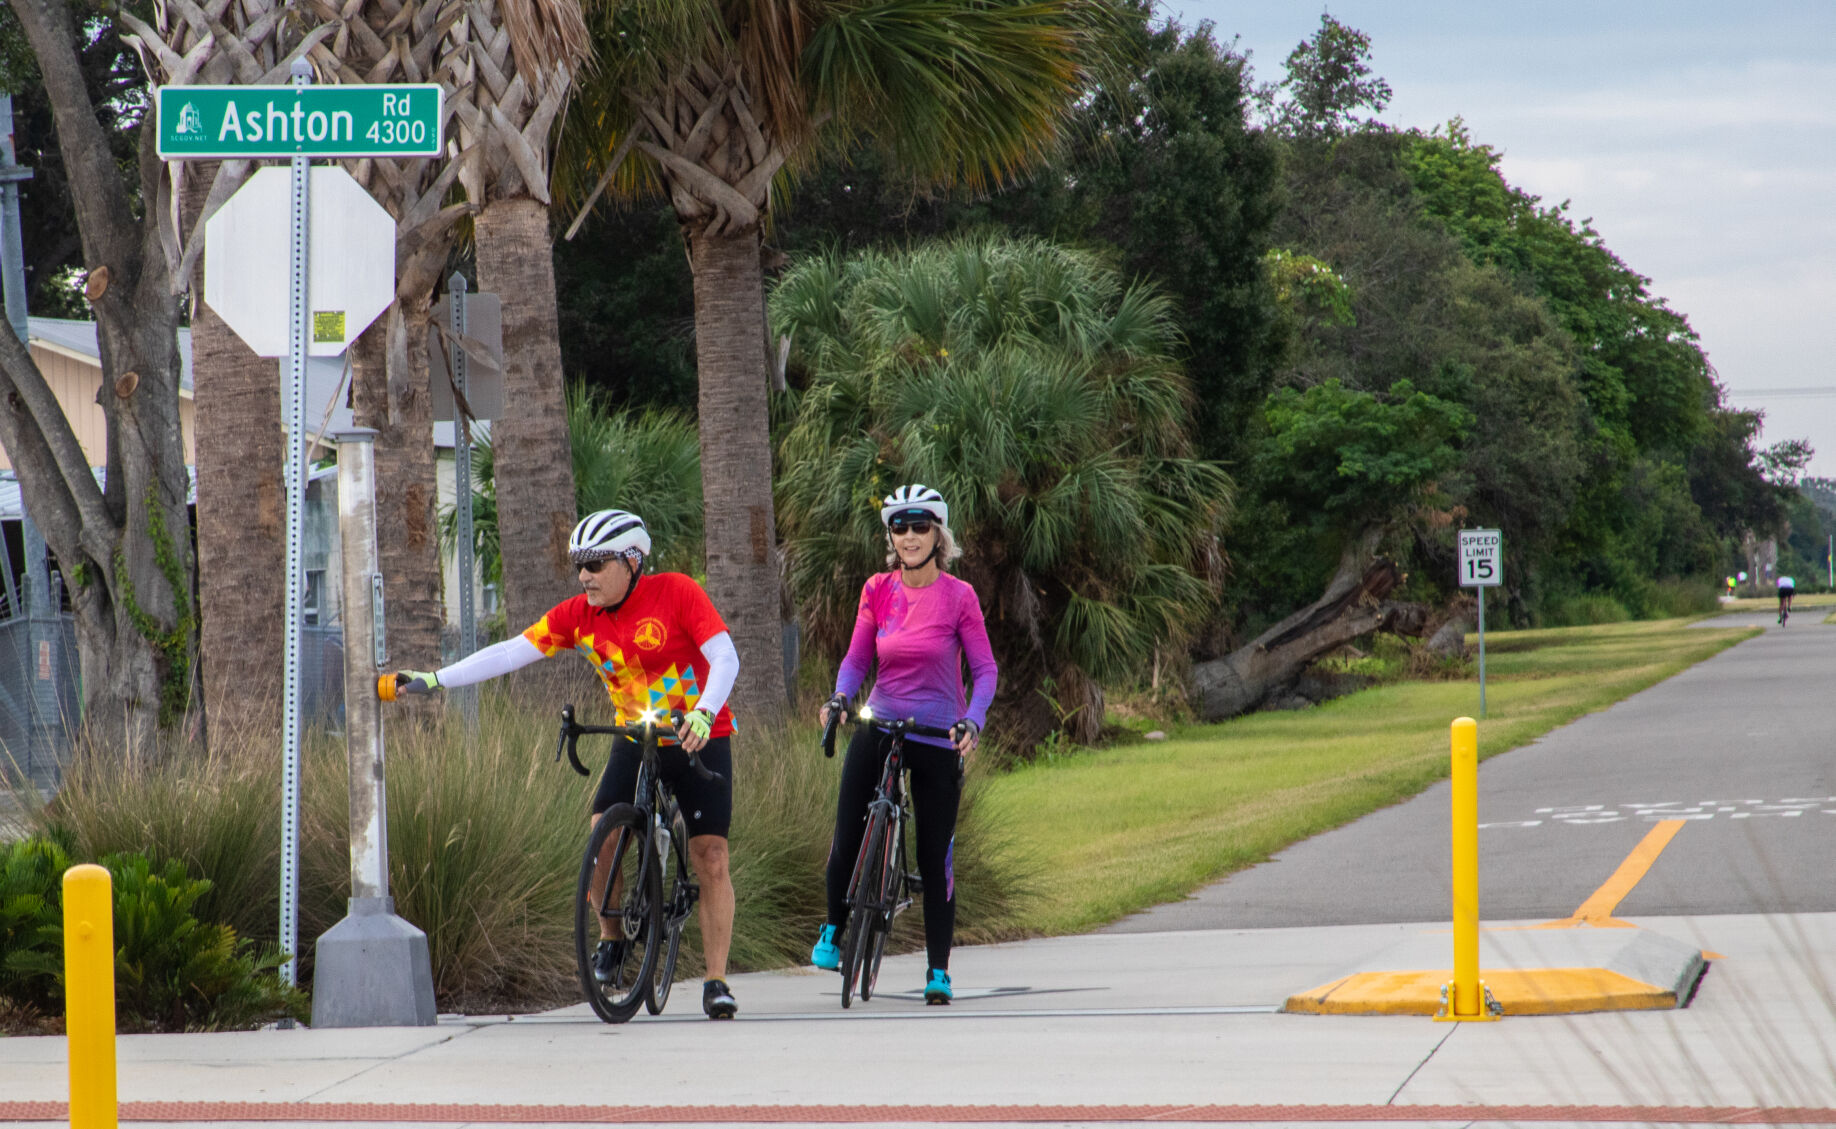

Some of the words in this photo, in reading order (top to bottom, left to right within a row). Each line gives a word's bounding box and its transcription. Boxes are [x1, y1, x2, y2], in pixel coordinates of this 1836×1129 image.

[383, 93, 410, 116] Rd
[218, 100, 353, 142] Ashton
[366, 120, 425, 144] 4300
[1462, 536, 1499, 546] SPEED
[1466, 548, 1494, 557] LIMIT
[1467, 559, 1494, 579] 15
[1477, 808, 1836, 829] HEAD
